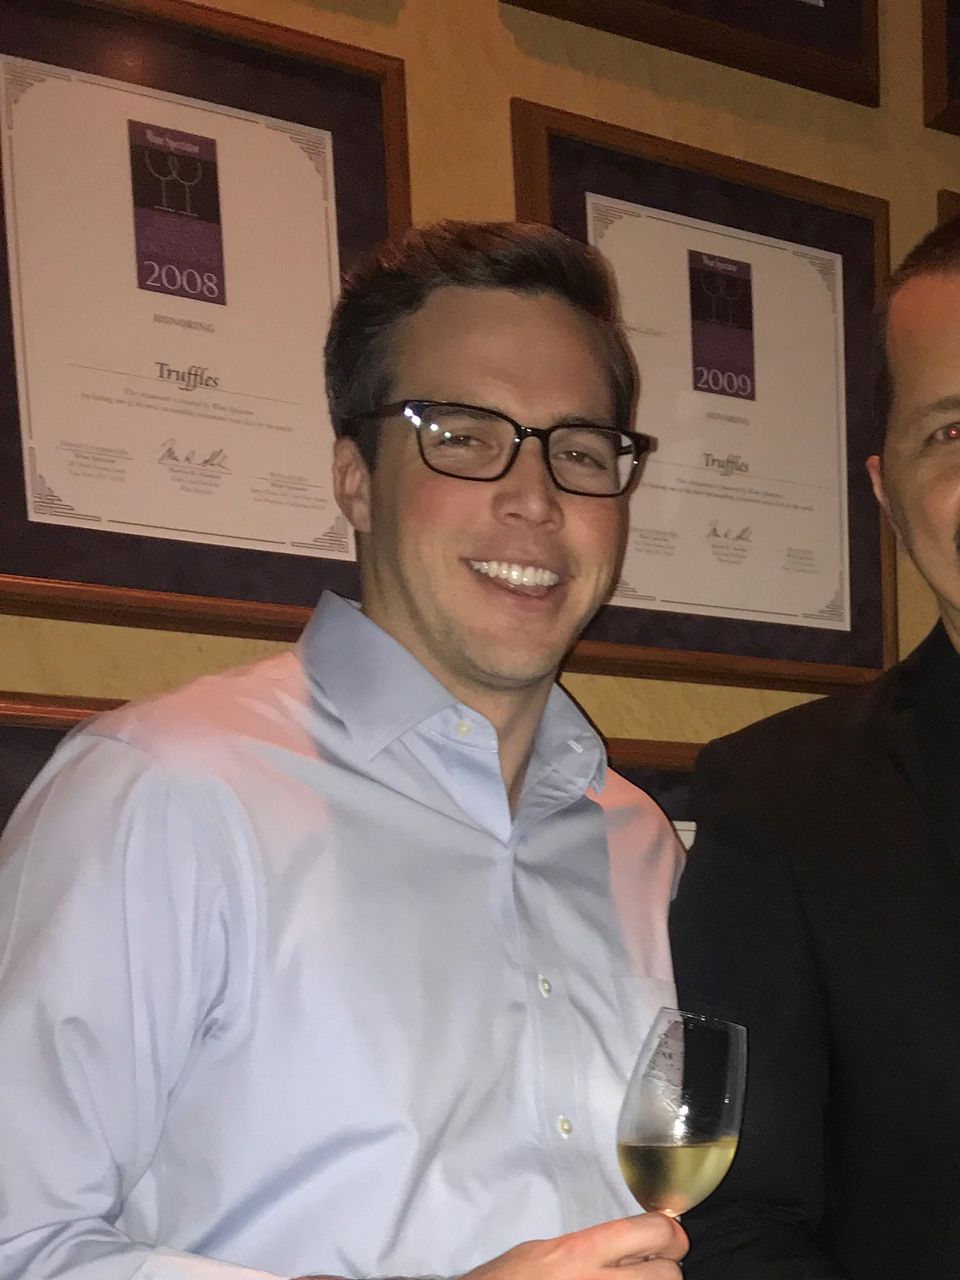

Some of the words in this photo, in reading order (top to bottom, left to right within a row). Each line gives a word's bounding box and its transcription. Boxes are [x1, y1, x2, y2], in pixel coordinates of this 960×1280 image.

[143, 259, 219, 298] 2008
[155, 361, 220, 391] Truffles
[695, 366, 752, 395] 2009
[703, 453, 750, 476] Truffles
